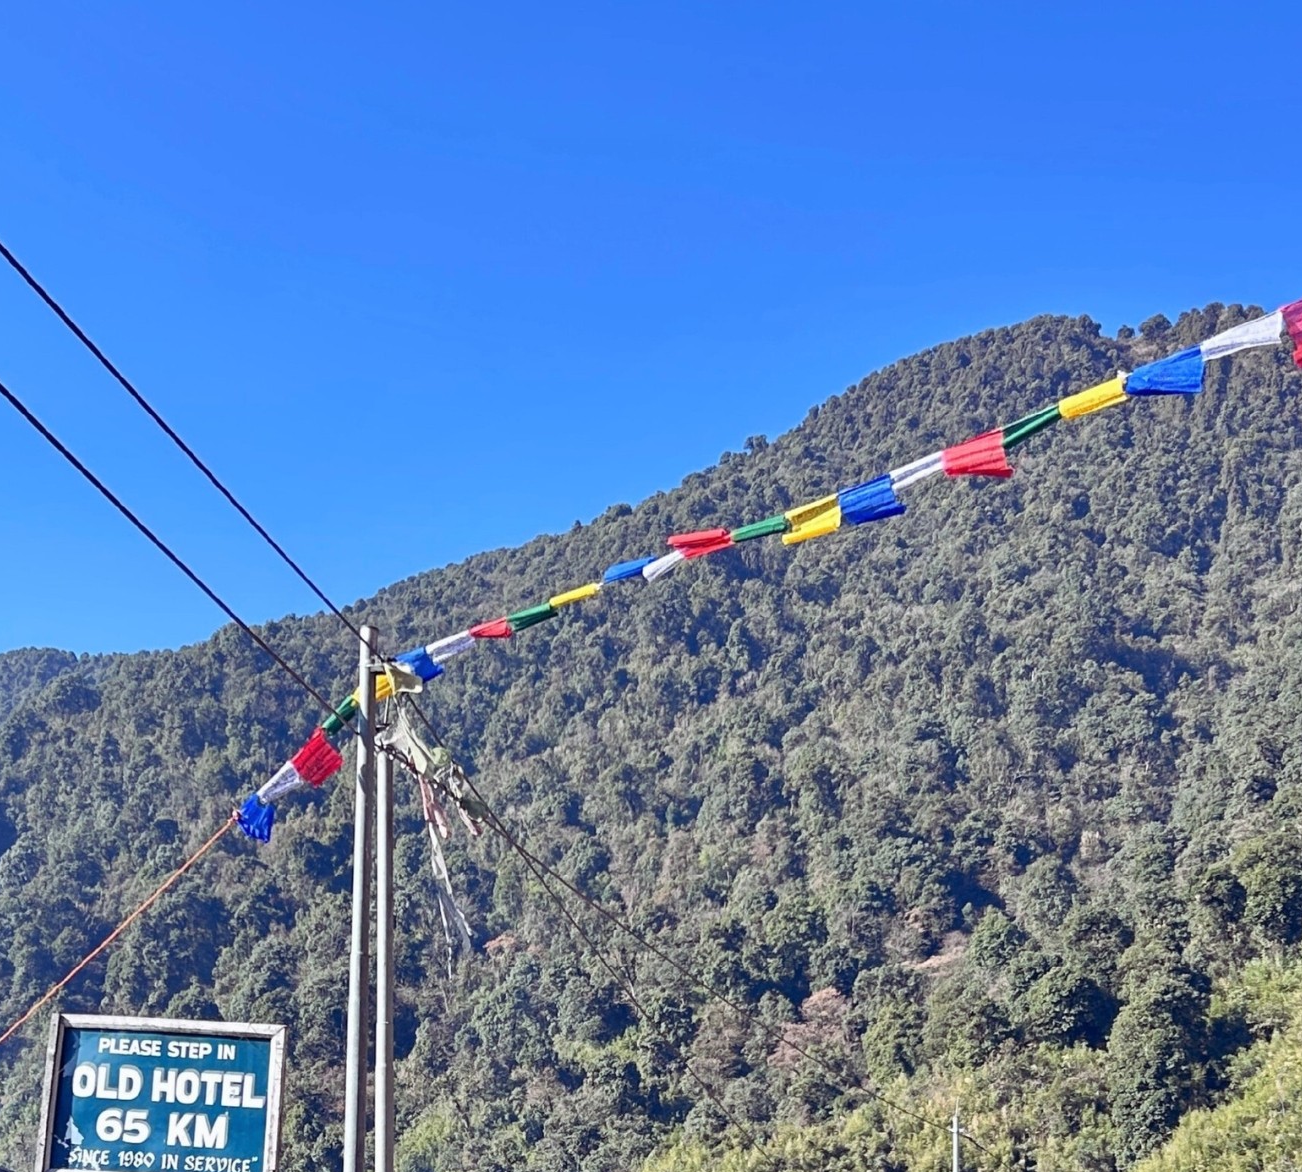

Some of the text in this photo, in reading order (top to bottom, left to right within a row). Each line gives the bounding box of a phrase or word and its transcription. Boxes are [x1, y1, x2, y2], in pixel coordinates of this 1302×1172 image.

[98, 1037, 236, 1060] PLEASE STEP IN
[72, 1061, 266, 1109] OLD HOTEL
[95, 1107, 229, 1149] 65 KM
[68, 1147, 110, 1167] SINCE
[118, 1150, 155, 1168] 1980
[161, 1154, 179, 1170] IN
